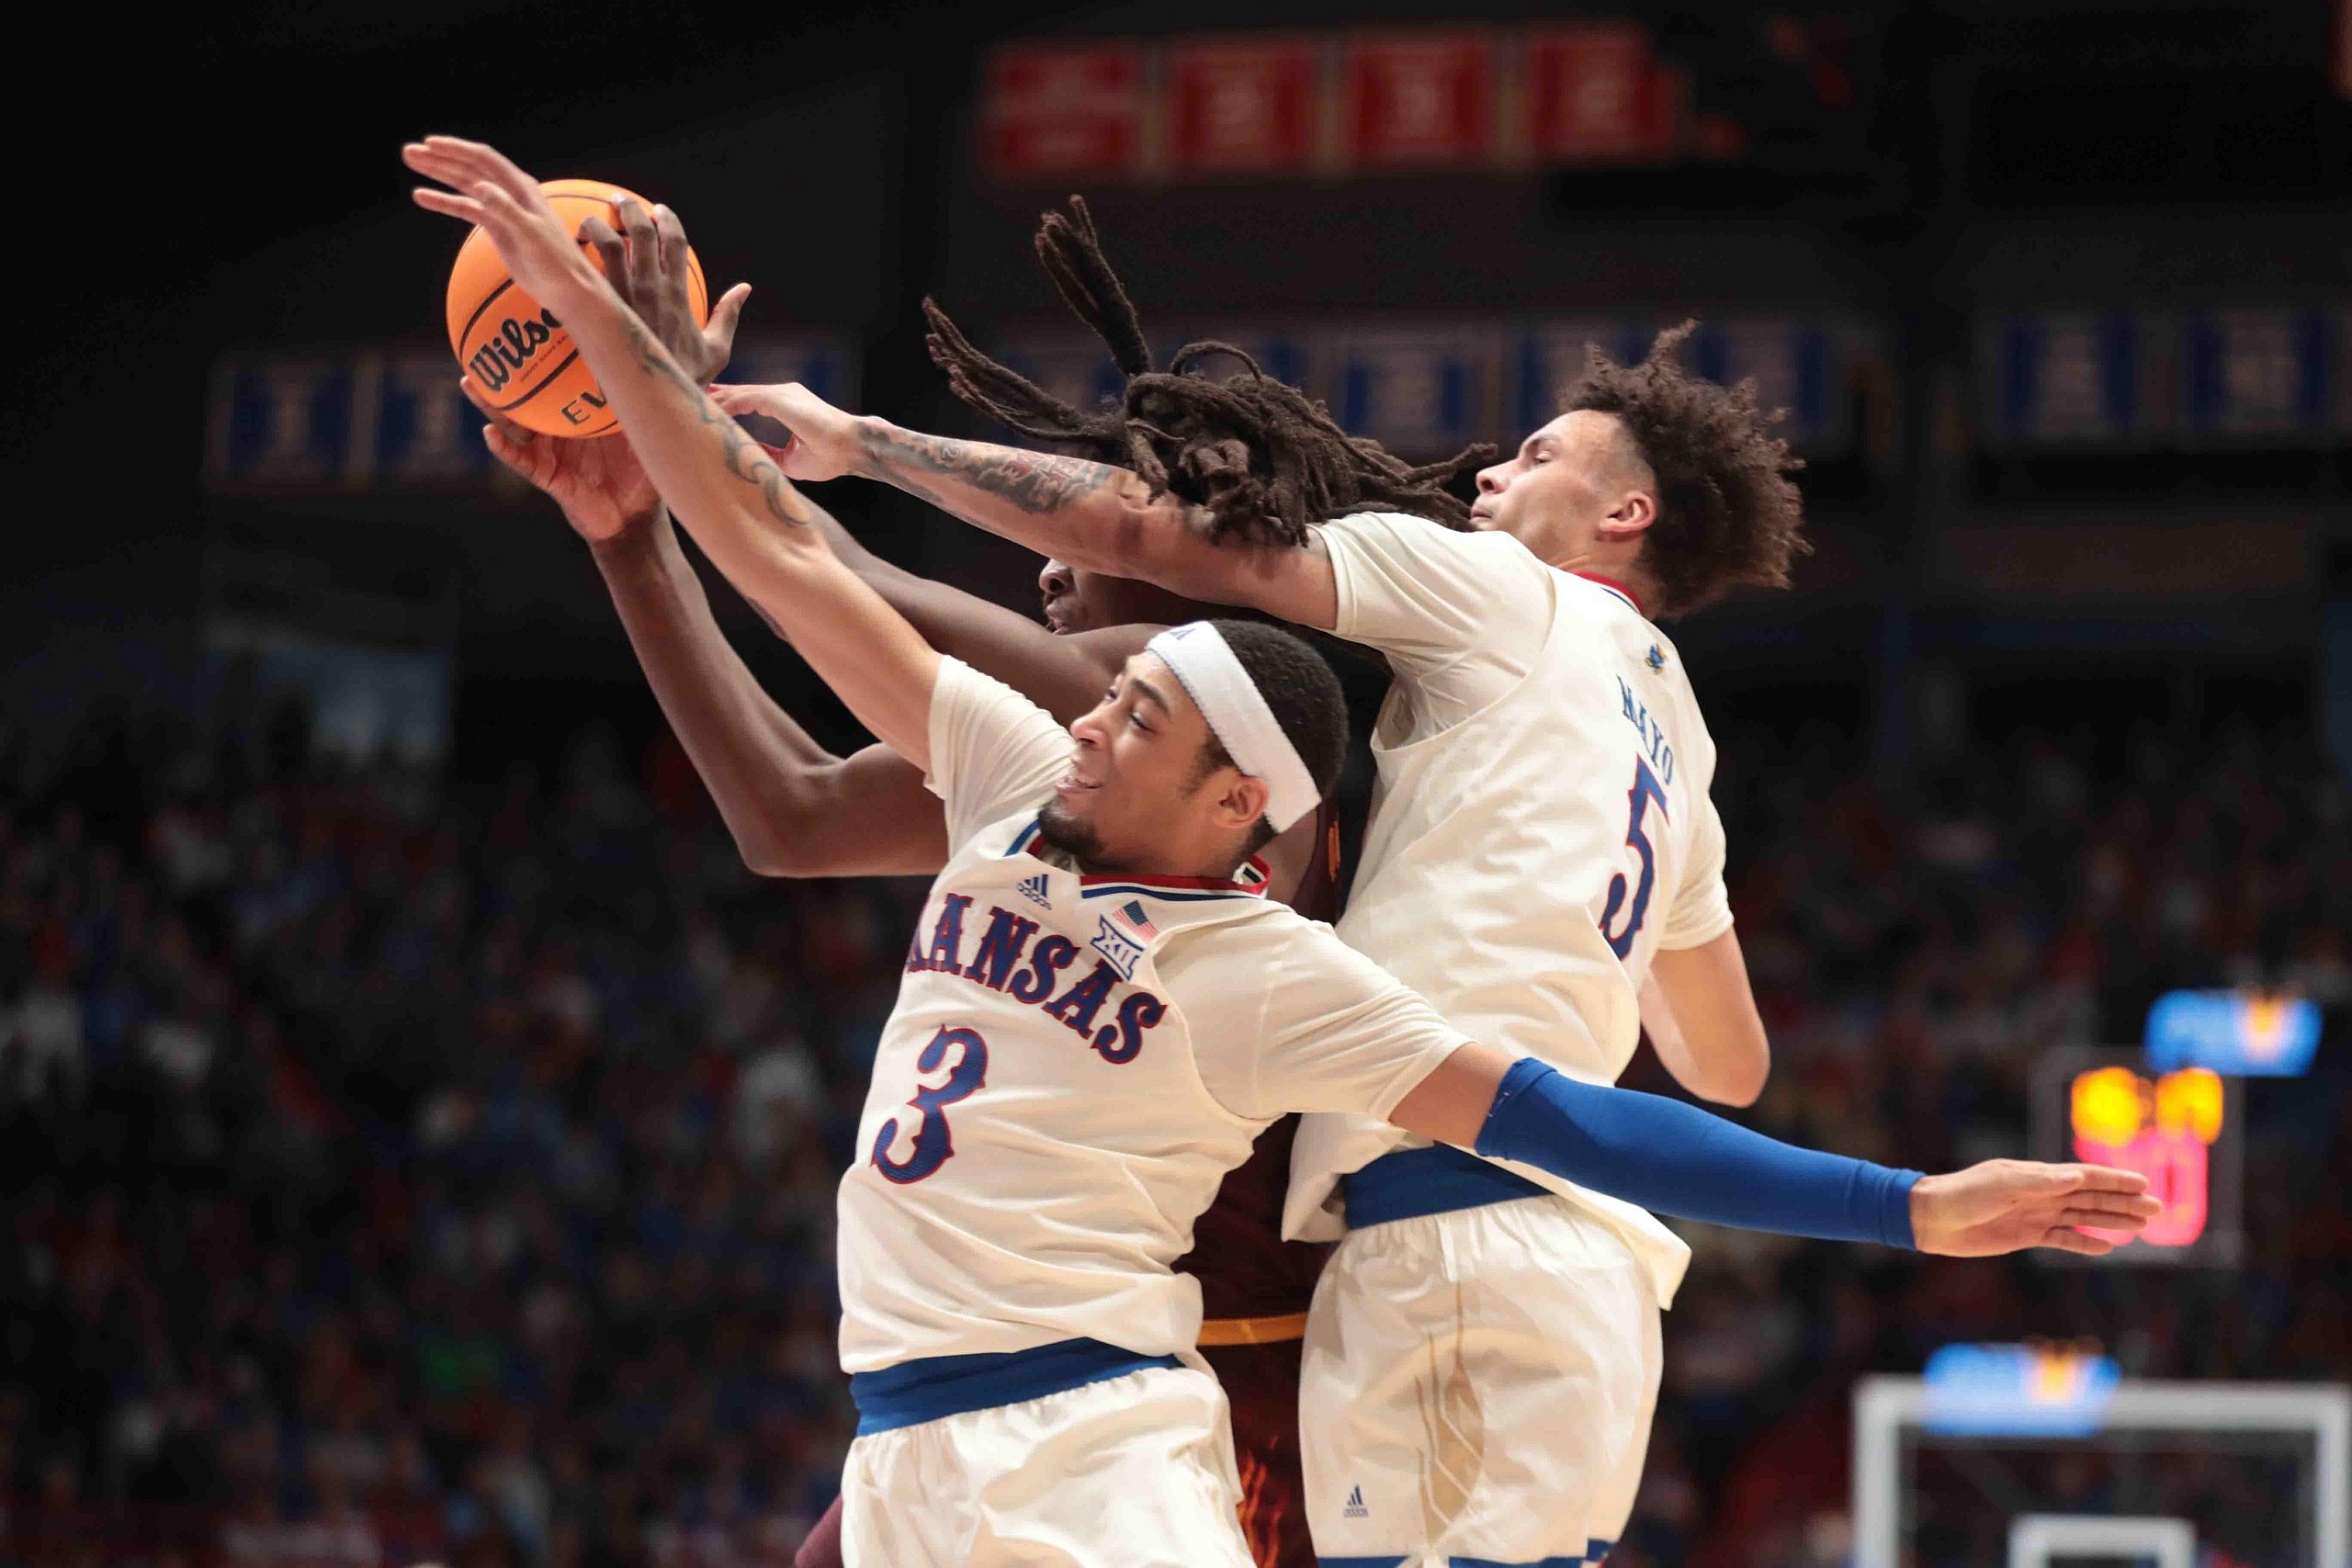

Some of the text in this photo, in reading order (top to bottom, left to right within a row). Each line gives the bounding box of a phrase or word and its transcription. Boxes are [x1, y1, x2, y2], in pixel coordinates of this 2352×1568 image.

[1616, 674, 1673, 785] MAYO
[1598, 752, 1670, 961] 5
[869, 1022, 989, 1184] 3
